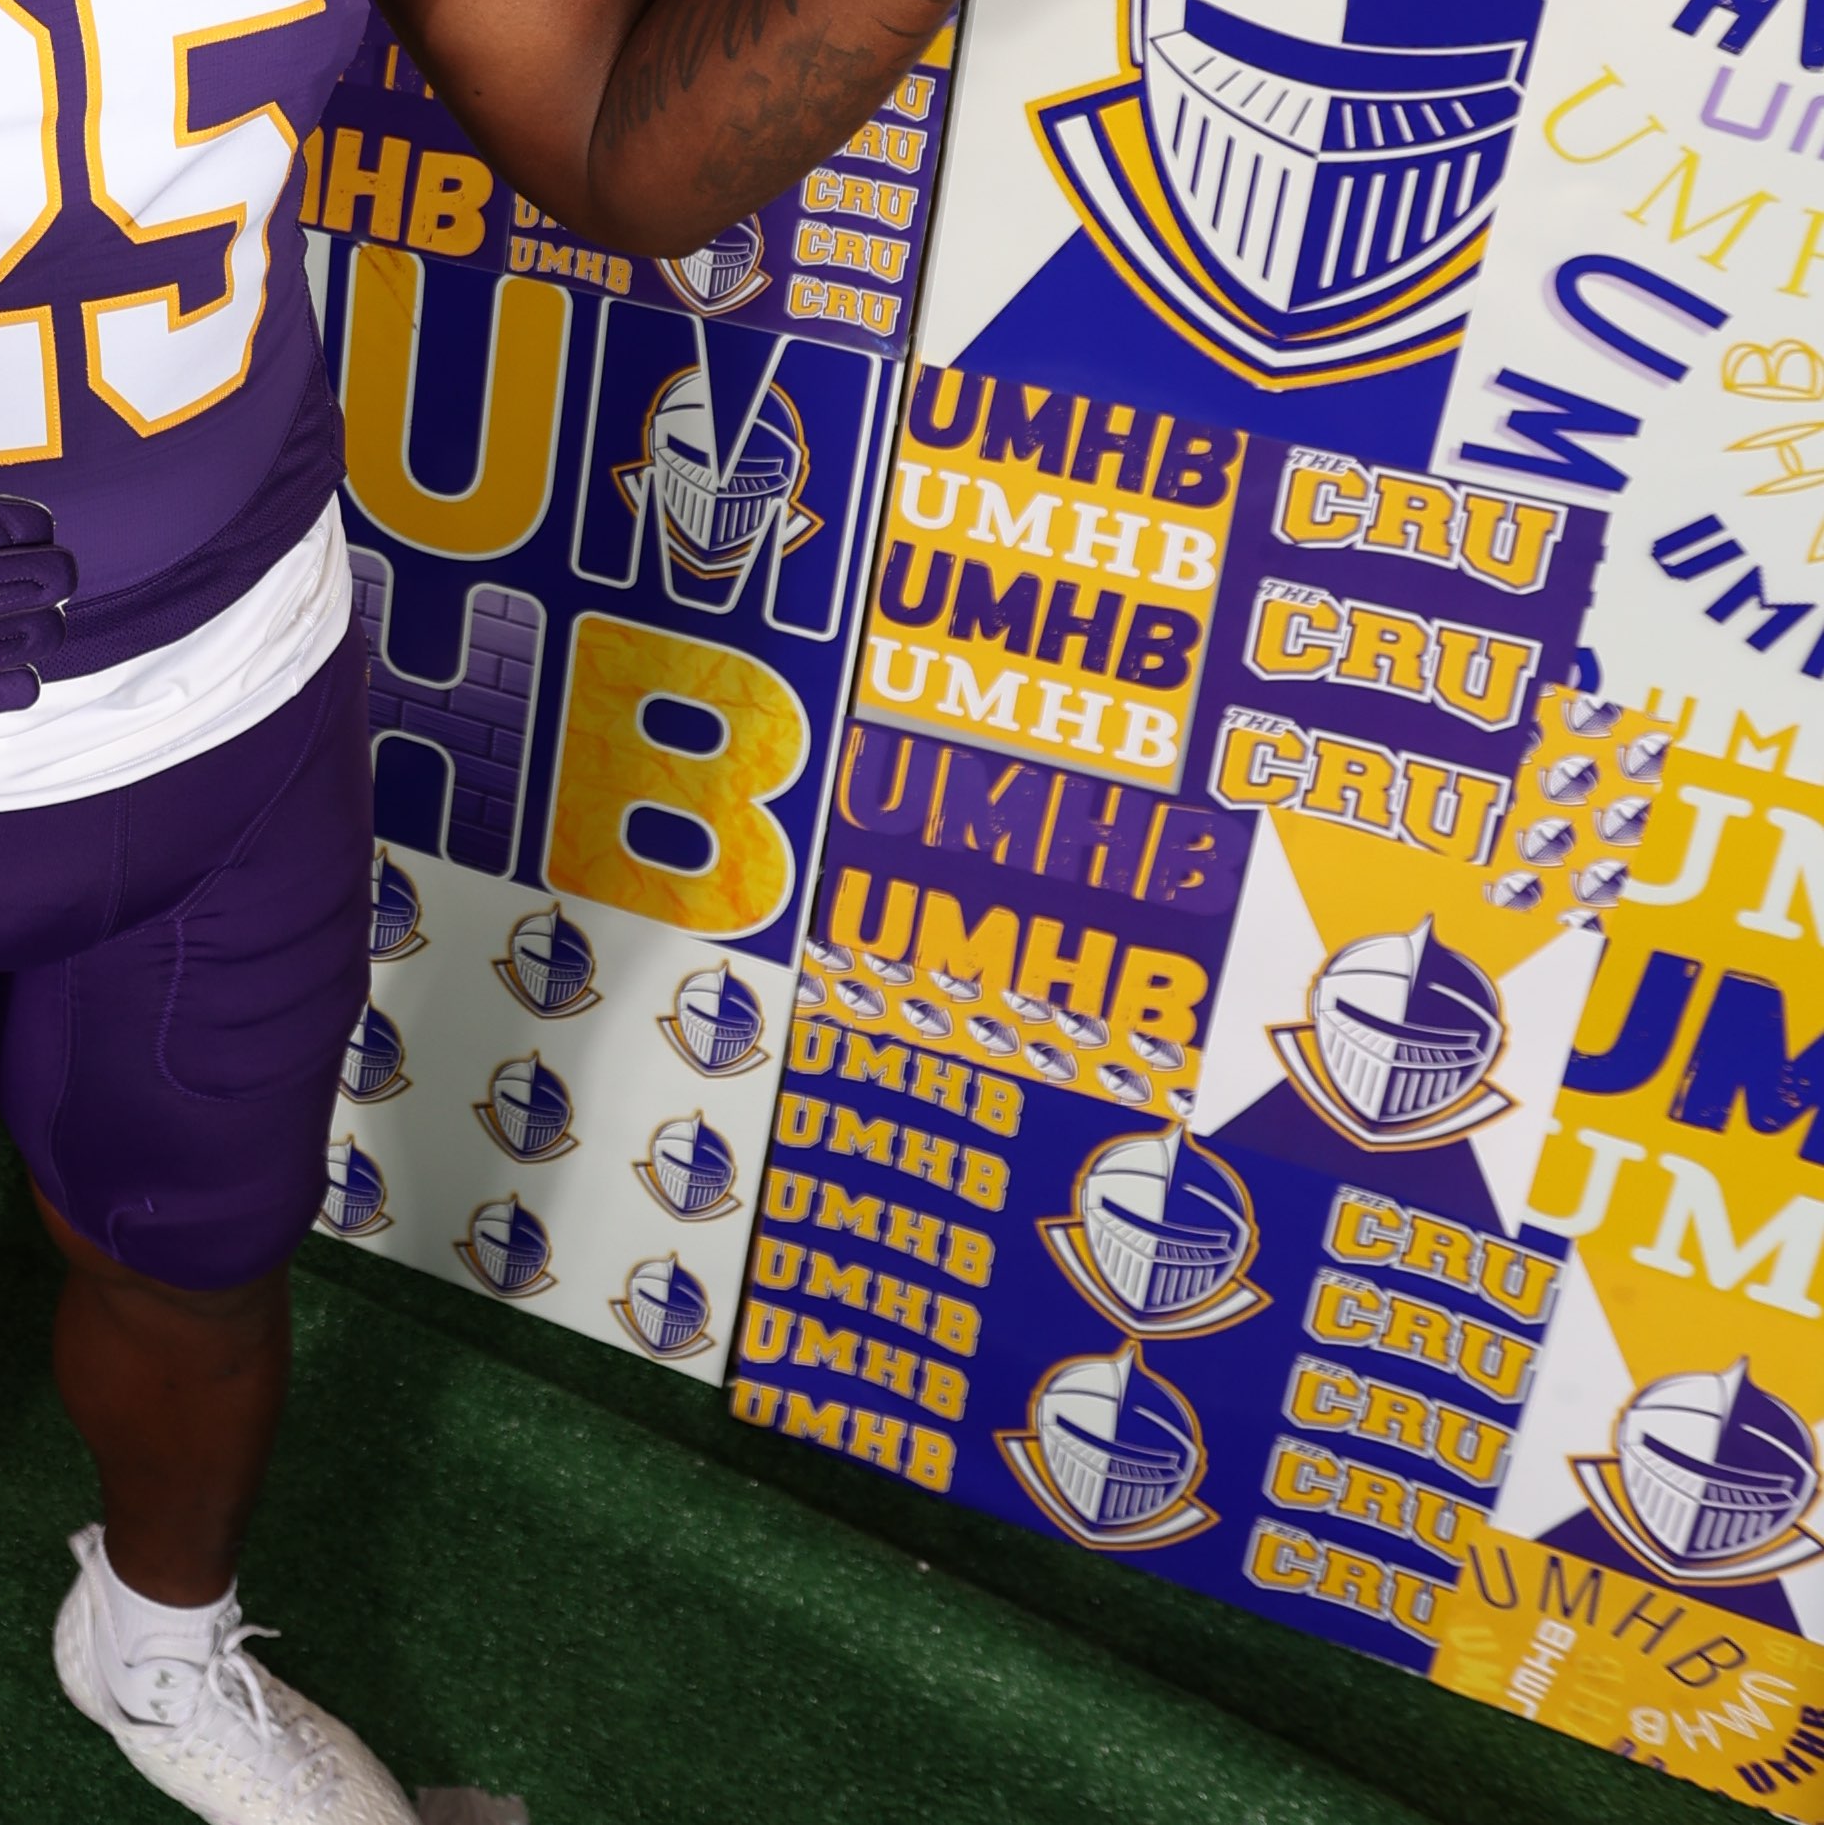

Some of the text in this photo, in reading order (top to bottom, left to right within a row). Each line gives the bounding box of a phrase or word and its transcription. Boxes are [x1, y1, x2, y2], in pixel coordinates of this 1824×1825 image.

[792, 221, 912, 284] CRU
[800, 169, 919, 231] CRU
[510, 235, 633, 298] UMHB
[786, 276, 902, 338] CRU
[907, 366, 1245, 509] UMHB
[895, 462, 1218, 591] UMHB
[1273, 447, 1568, 595] THE CRU
[879, 539, 1204, 691] UMHB
[1243, 579, 1542, 732] THE CRU
[868, 636, 1178, 769] UMHB
[1225, 707, 1295, 735] THE
[836, 726, 1253, 916] UMHB
[1208, 709, 1512, 867] CRU
[830, 868, 1210, 1046] UMHB
[788, 1016, 1024, 1138] UMHB
[774, 1091, 1011, 1212] UMHB
[761, 1168, 996, 1288] UMHB
[1323, 1184, 1567, 1324] CRU
[741, 1298, 970, 1422] UMHB
[751, 1235, 982, 1357] UMHB
[1303, 1268, 1544, 1405] CRU
[730, 1377, 958, 1493] UMHB
[1281, 1354, 1518, 1489] CRU
[1262, 1436, 1490, 1565] CRU
[1243, 1517, 1456, 1647] CRU
[1467, 1544, 1748, 1688] UMHB
